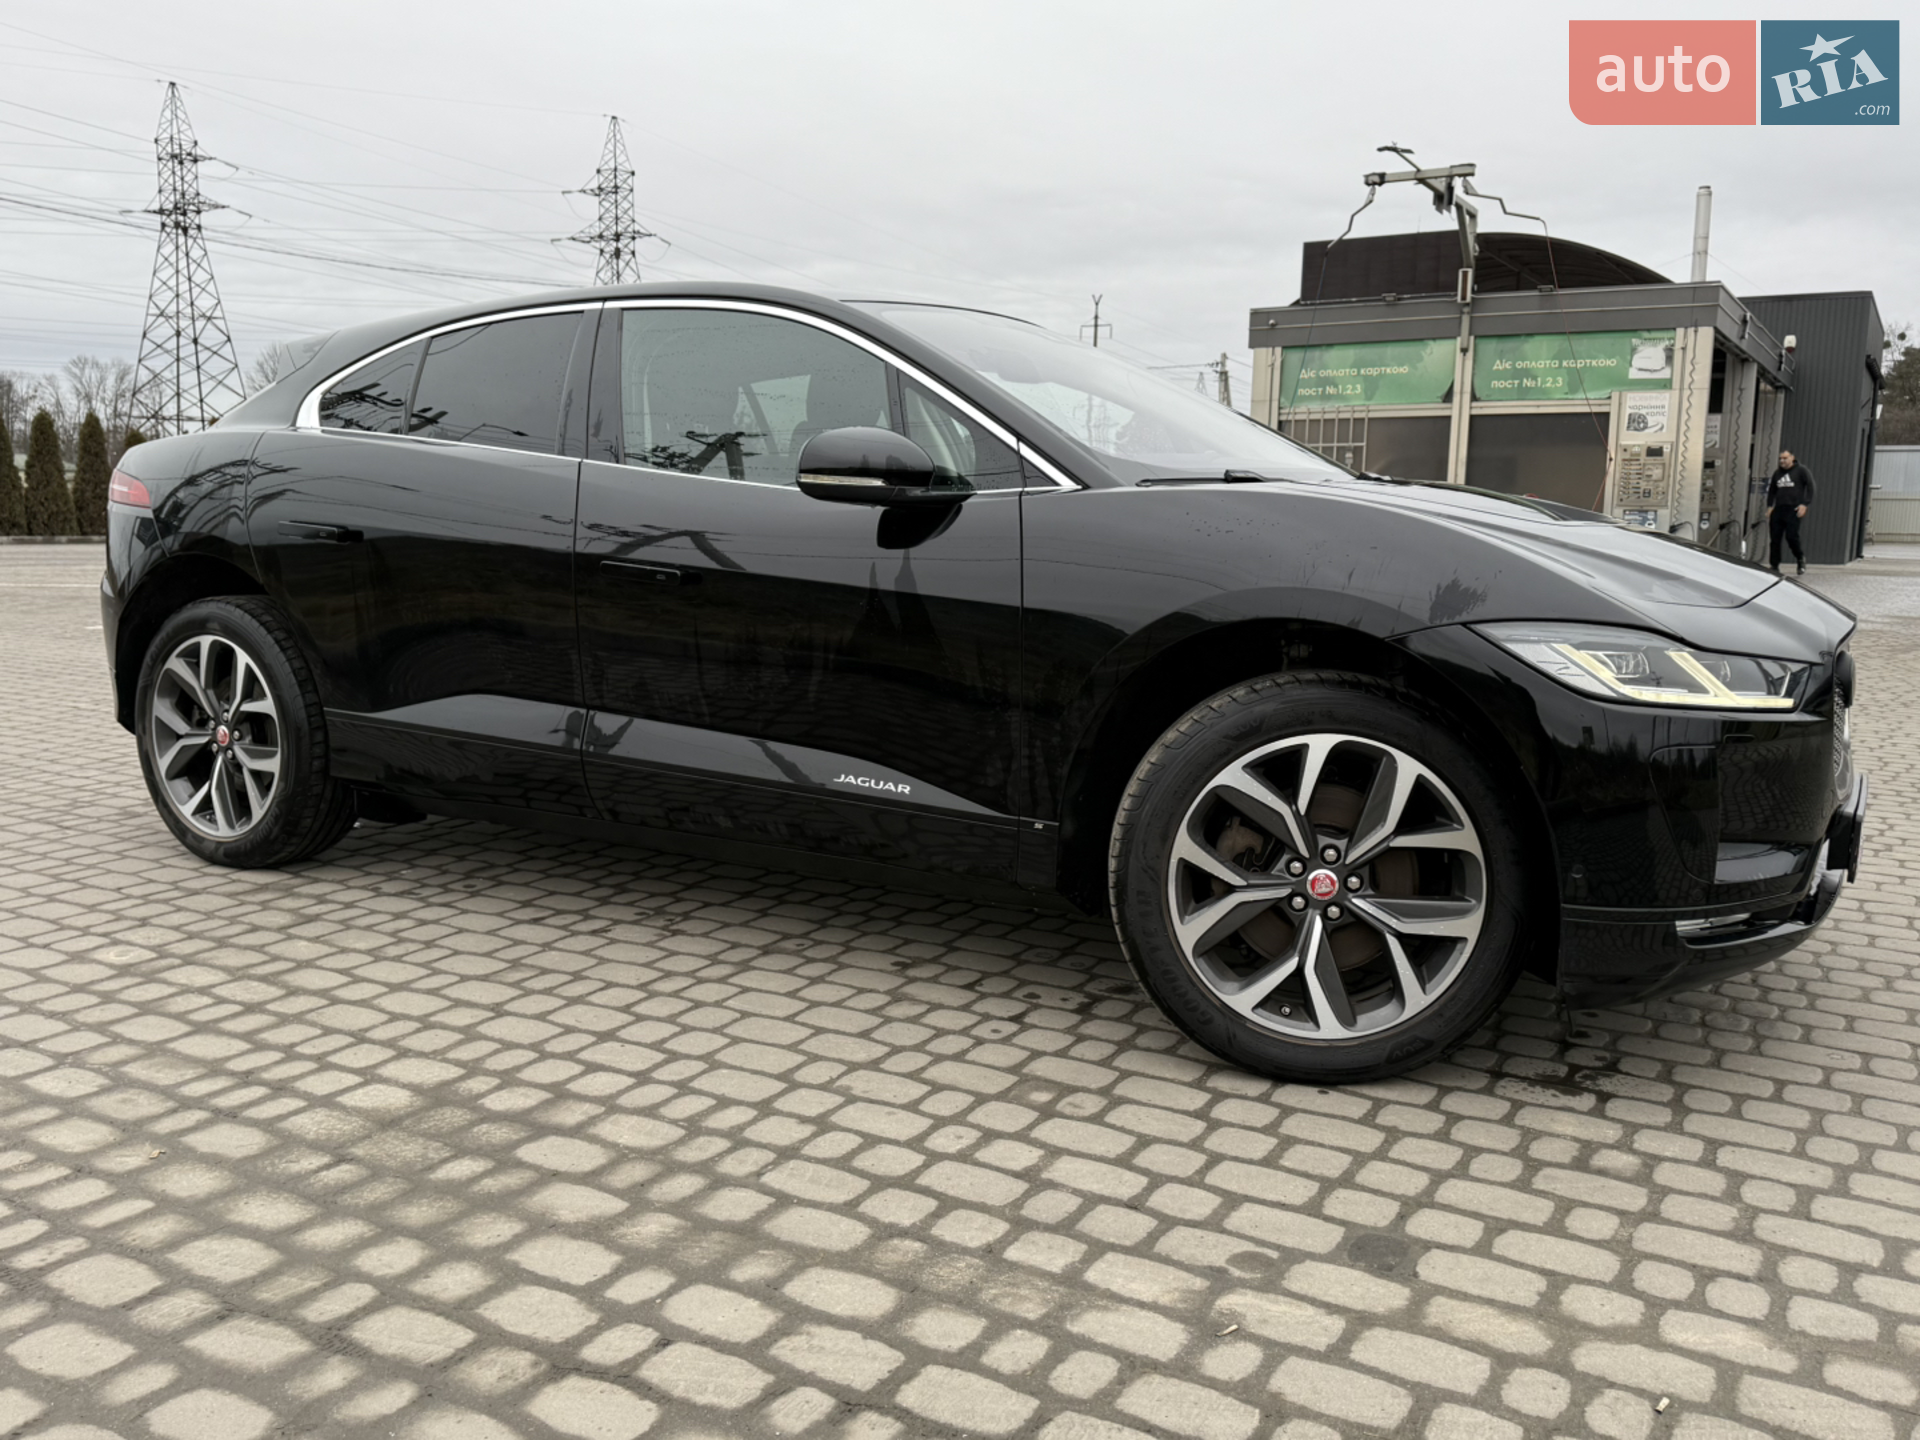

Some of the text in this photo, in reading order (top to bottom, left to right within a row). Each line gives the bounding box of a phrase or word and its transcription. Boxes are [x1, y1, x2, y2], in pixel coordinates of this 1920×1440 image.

[1492, 358, 1617, 371] Діє оплата карткою
[1300, 364, 1409, 379] Діє оплата карткою
[1491, 376, 1564, 389] пост №1,2,3
[1298, 383, 1362, 396] пост №1,2,3
[833, 774, 911, 795] JAGUAR
